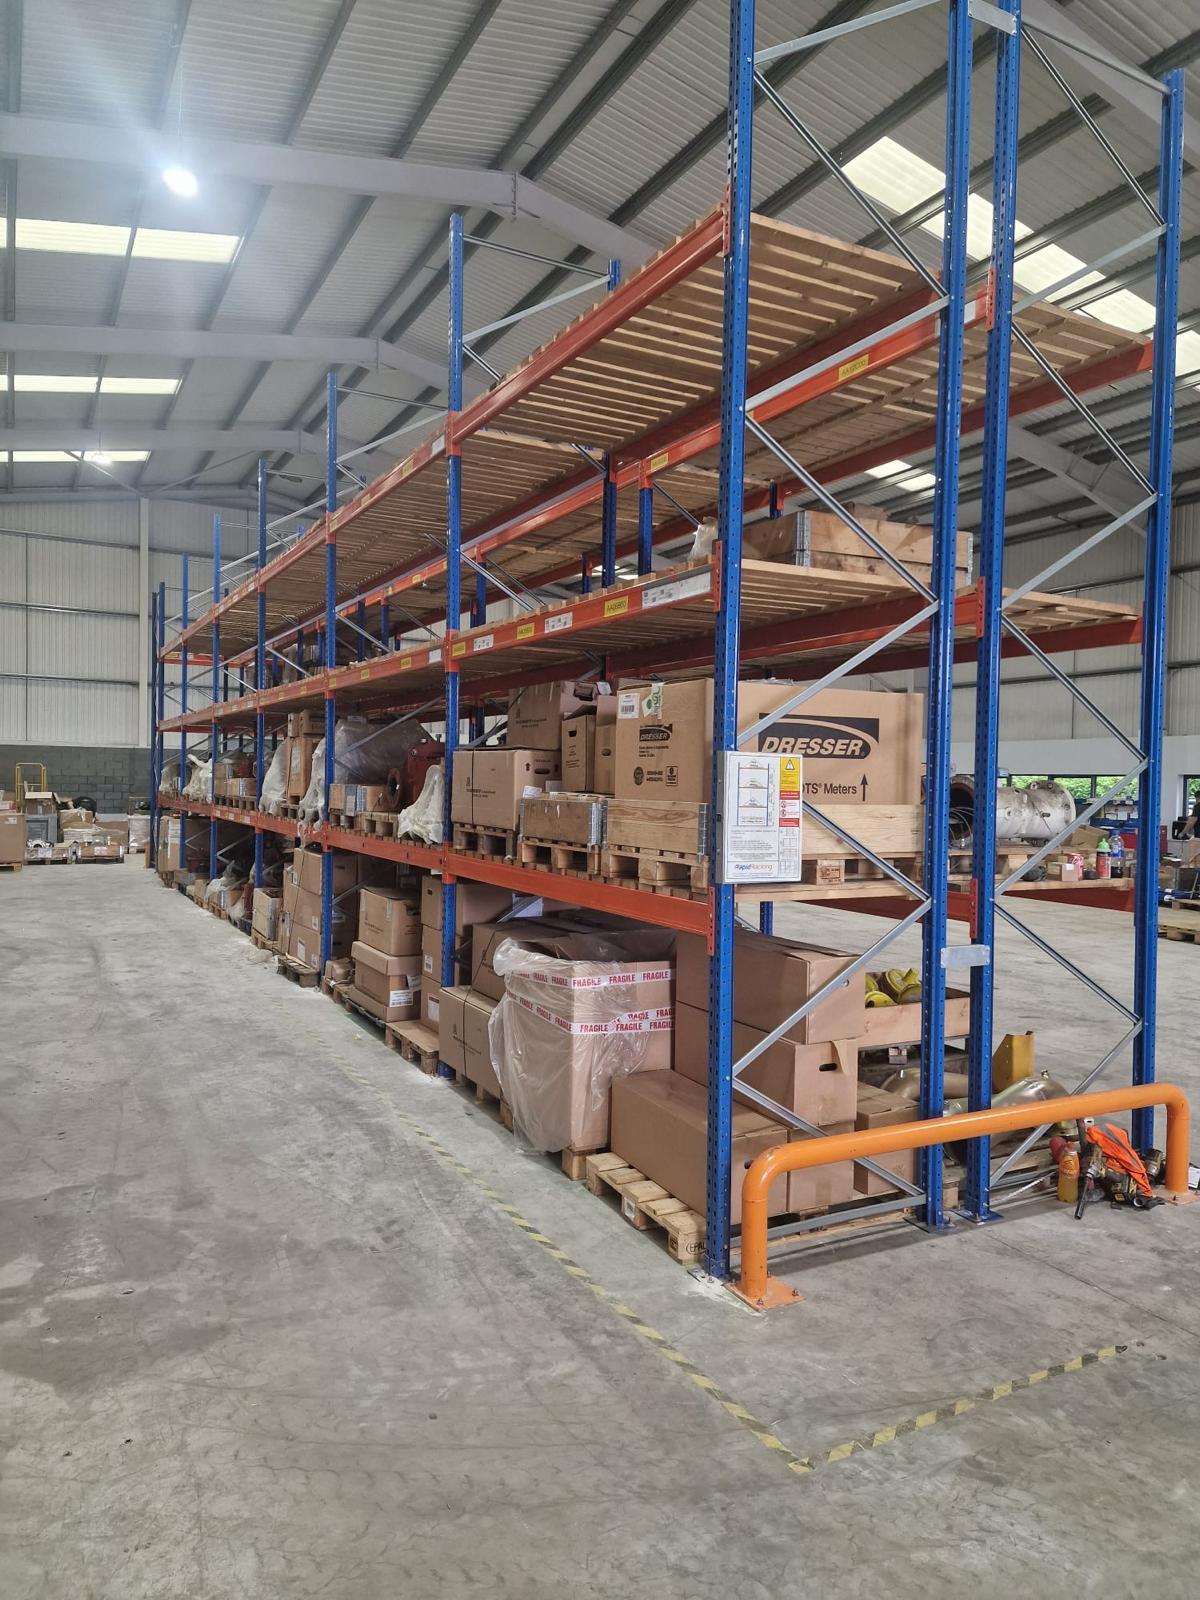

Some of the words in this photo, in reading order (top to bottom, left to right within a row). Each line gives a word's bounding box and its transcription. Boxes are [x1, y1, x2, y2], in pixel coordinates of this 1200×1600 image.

[761, 736, 863, 756] DRESSER
[823, 783, 857, 795] Meters
[609, 974, 636, 985] FRAGILE
[642, 970, 669, 981] FRAGILE
[554, 1016, 572, 1032] FRAGILE
[580, 1024, 609, 1033] FRAGILE
[616, 1022, 643, 1032] FRAGILE
[649, 1020, 673, 1030] FRAGIL
